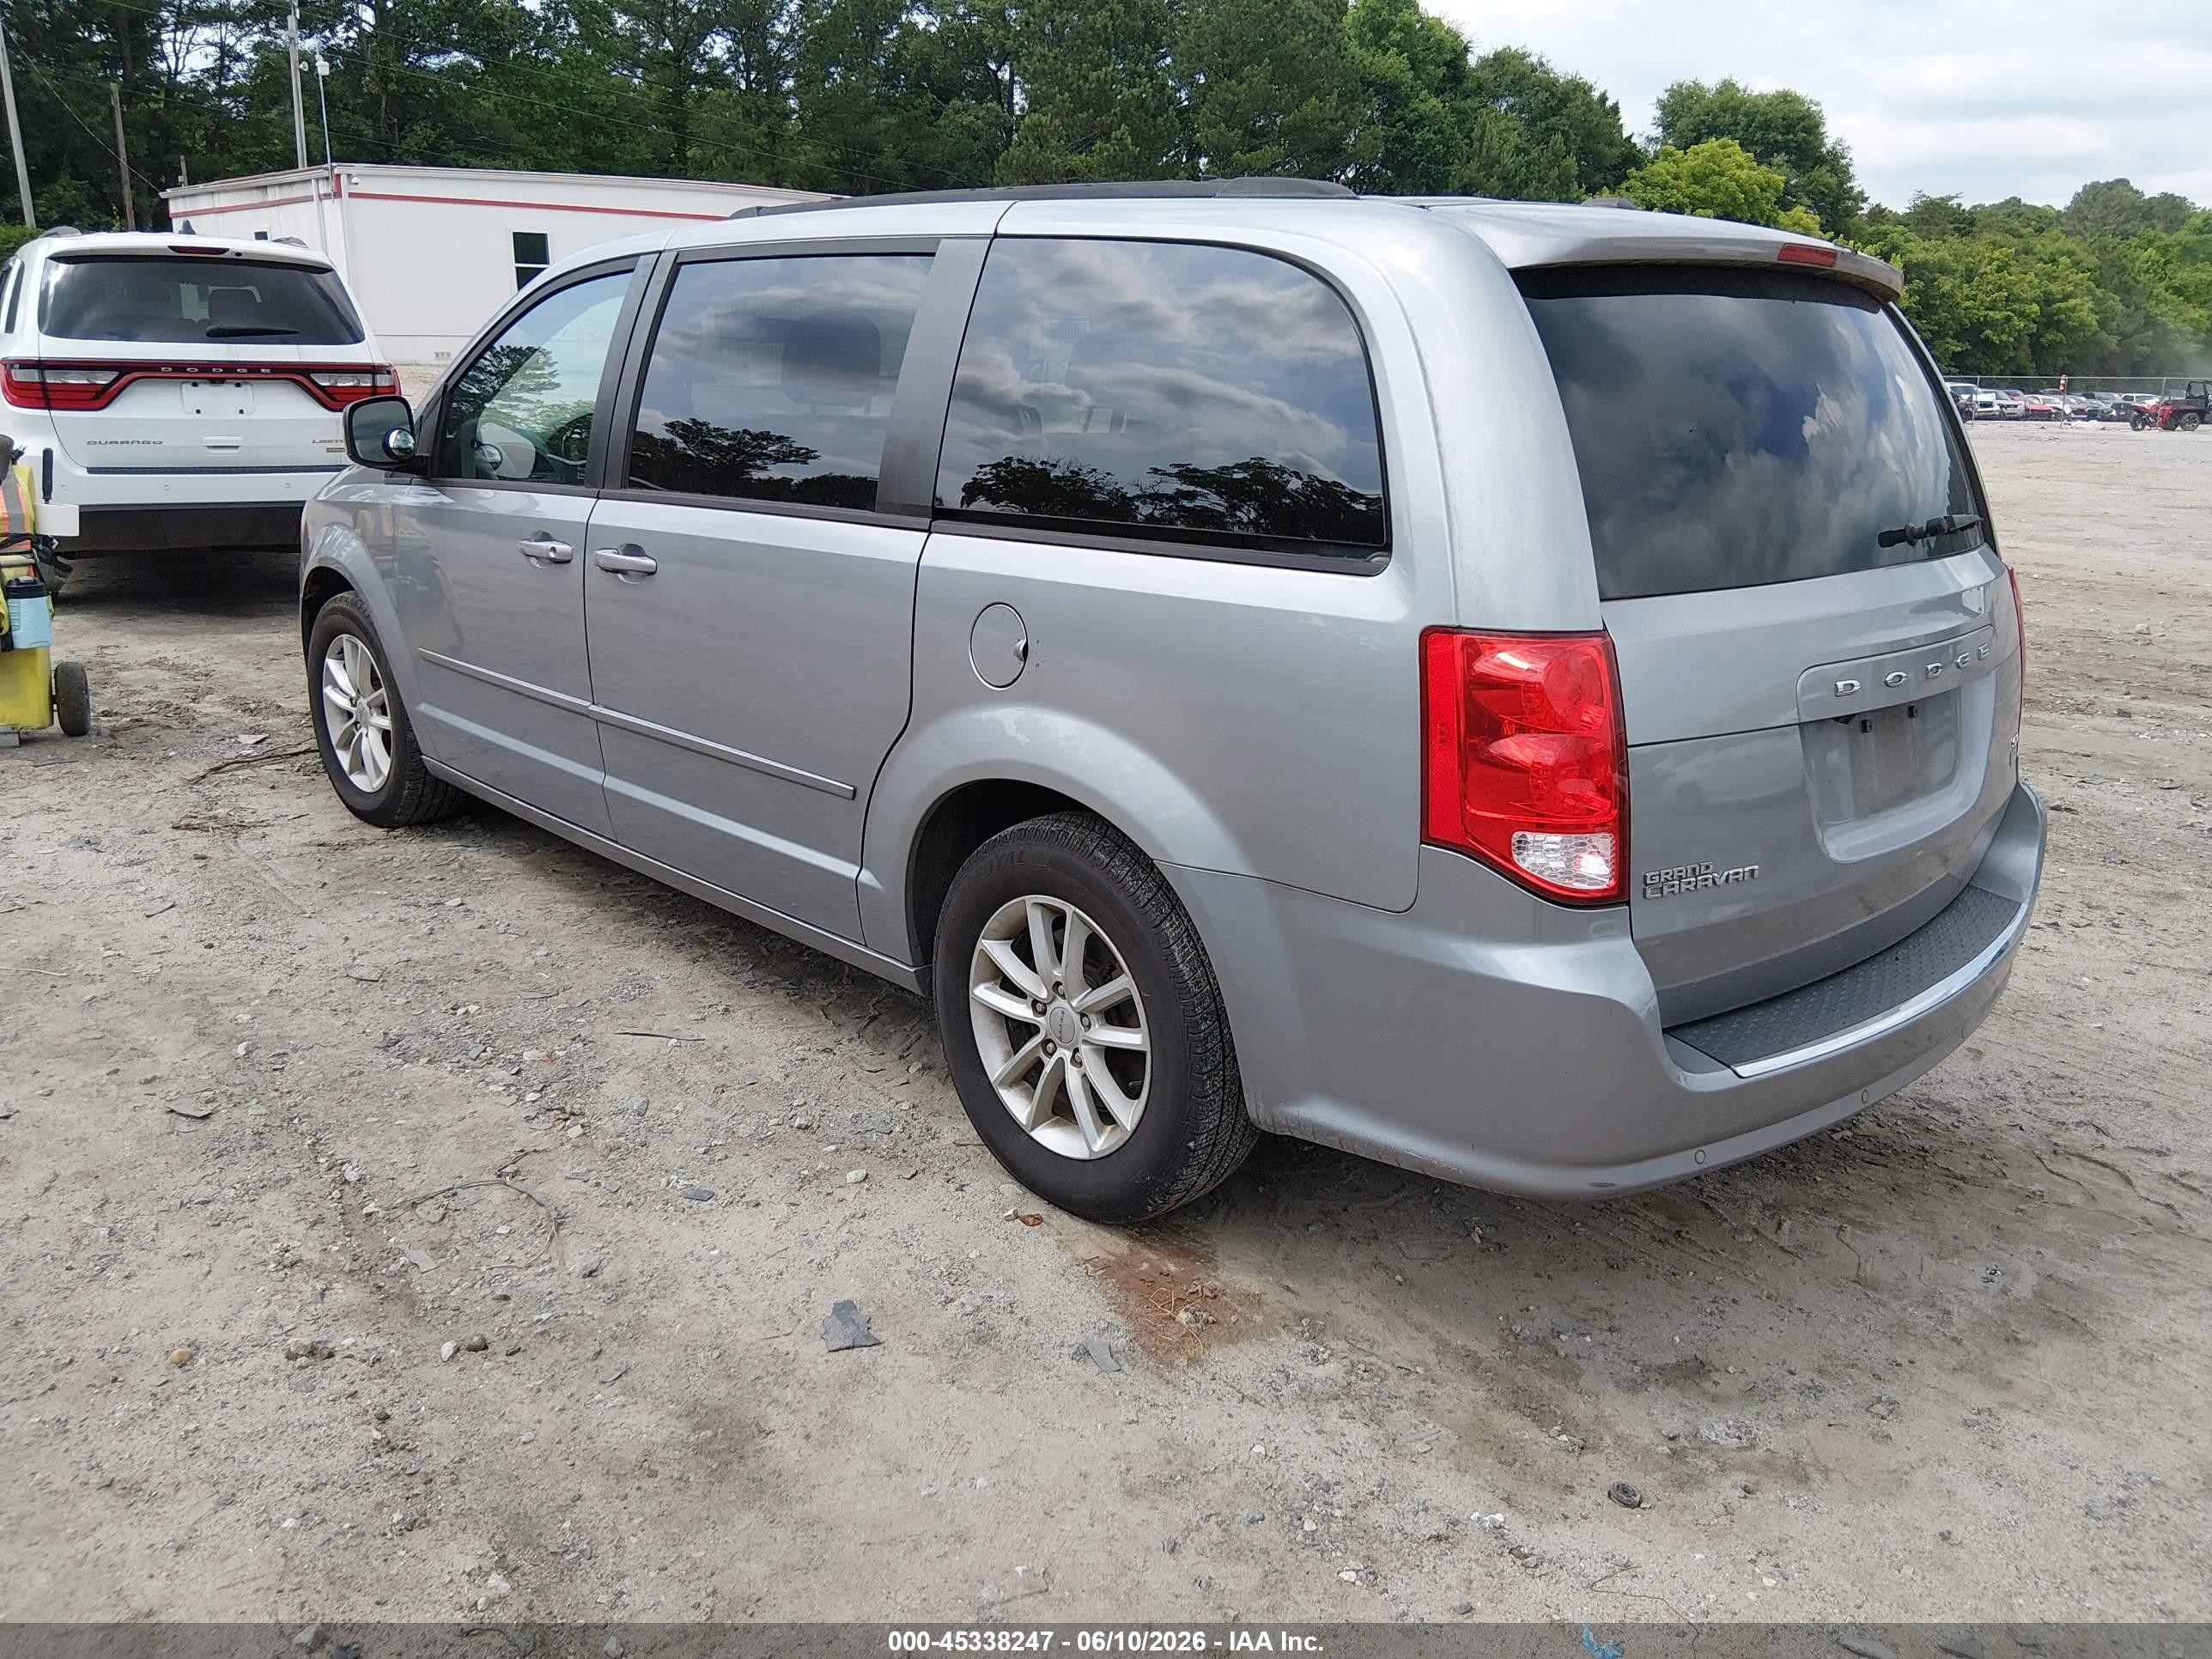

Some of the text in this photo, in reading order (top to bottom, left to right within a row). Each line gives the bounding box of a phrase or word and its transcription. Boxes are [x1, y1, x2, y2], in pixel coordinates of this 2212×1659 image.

[1834, 643, 1990, 697] DODGE
[1643, 860, 1714, 885] GRAND
[1643, 865, 1759, 900] CARAVAN
